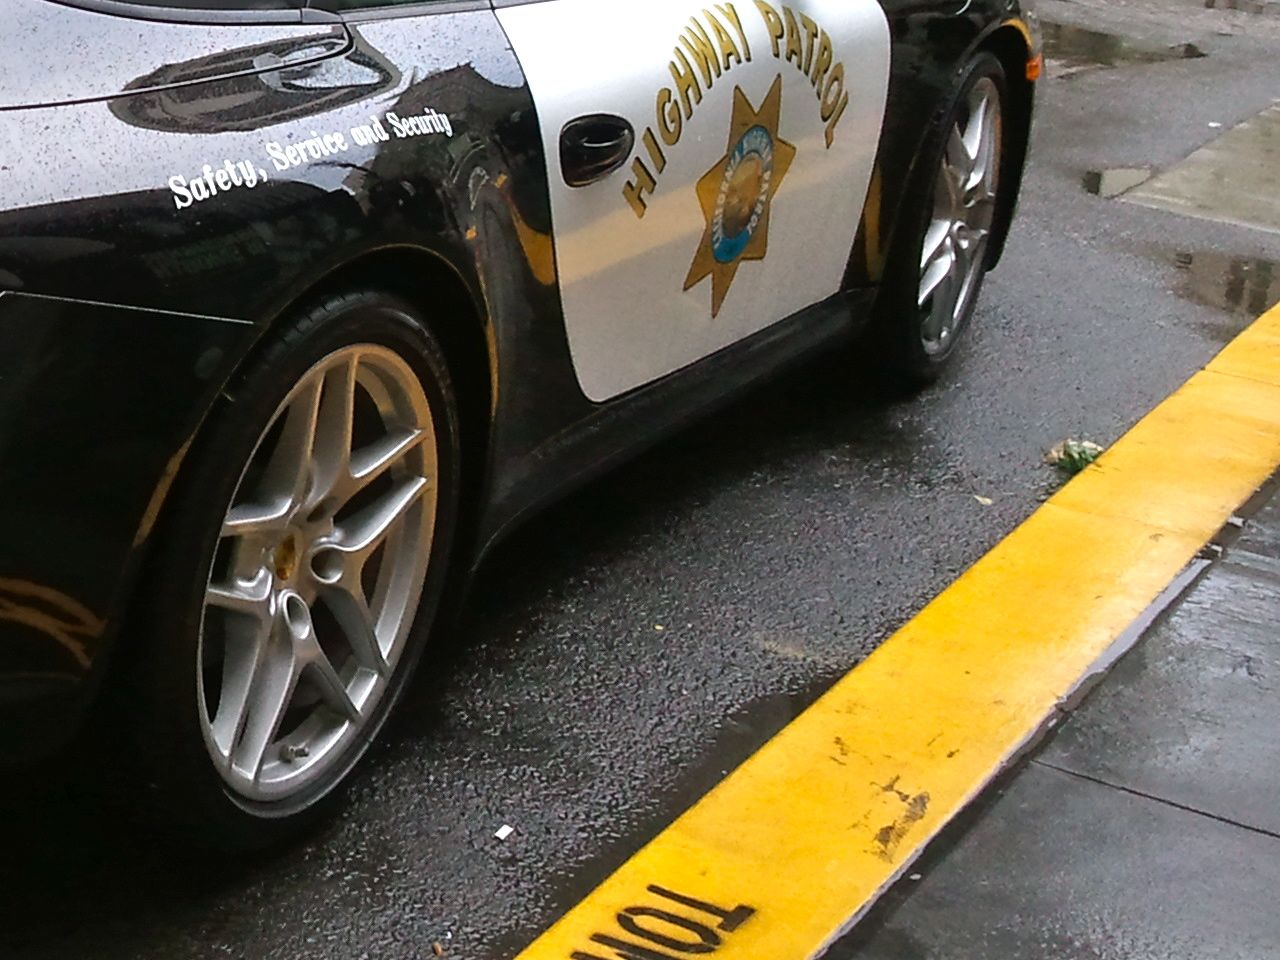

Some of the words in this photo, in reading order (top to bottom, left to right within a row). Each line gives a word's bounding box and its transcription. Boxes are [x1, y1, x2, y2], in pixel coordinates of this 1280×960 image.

[168, 156, 269, 210] Safety,
[265, 130, 349, 172] Service
[350, 115, 390, 147] and
[385, 107, 455, 139] Security
[622, 1, 752, 220] HIGHWAY
